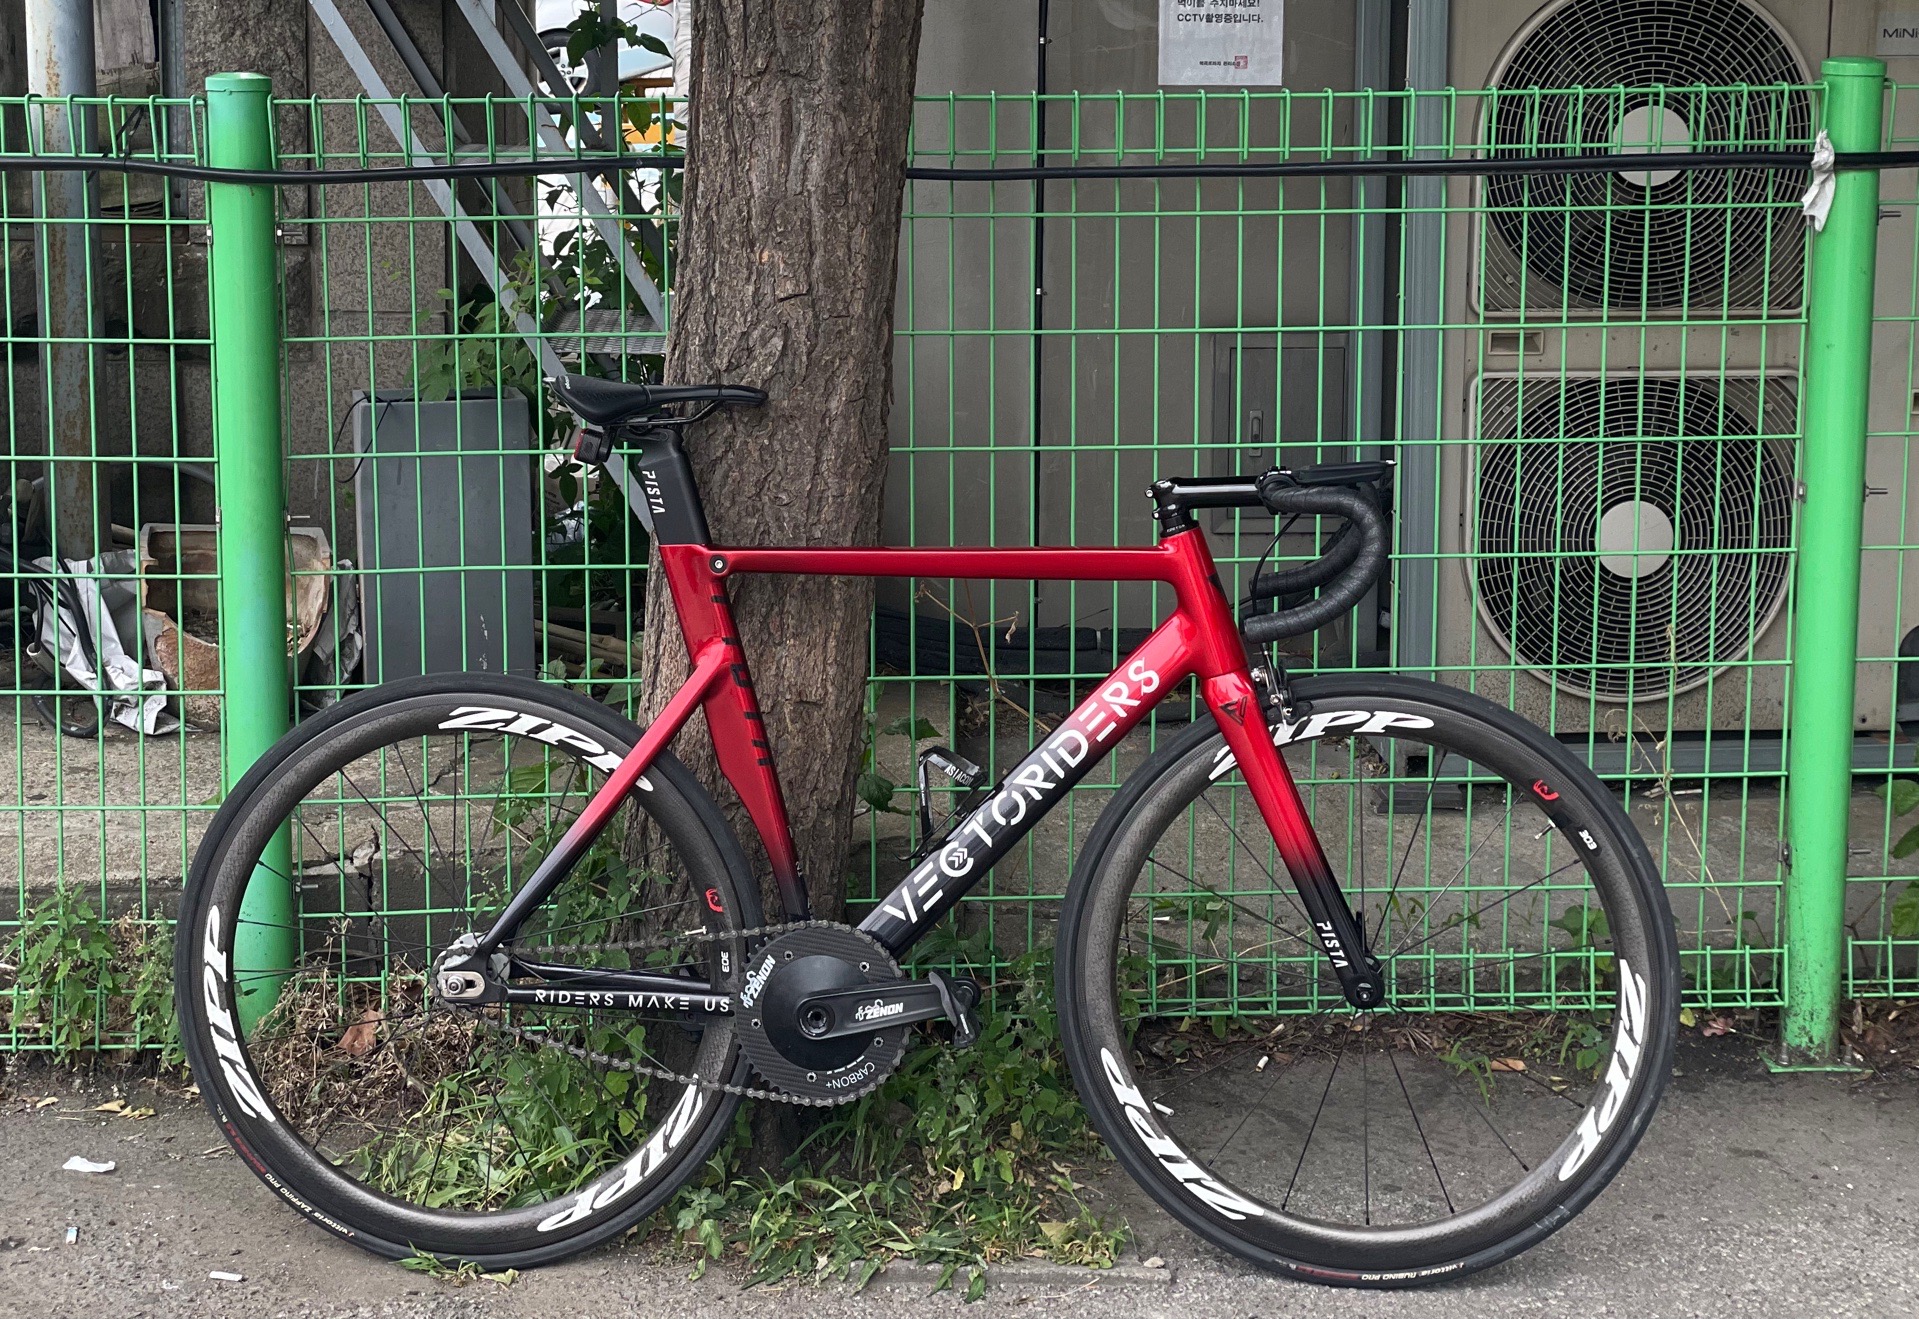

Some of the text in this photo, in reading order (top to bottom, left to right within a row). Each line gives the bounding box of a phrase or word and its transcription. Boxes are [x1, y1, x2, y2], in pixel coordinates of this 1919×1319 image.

[642, 470, 666, 514] PISTA
[1578, 829, 1598, 851] 303
[1316, 920, 1349, 968] PISTA
[720, 951, 730, 973] 303
[748, 954, 777, 999] ZENON
[204, 905, 276, 1123] ZIPP
[535, 989, 730, 1012] RIDERS MAKE US
[865, 1002, 904, 1020] ZENON
[825, 1062, 876, 1089] CARBON+
[1558, 958, 1646, 1182] ZIPP
[1101, 1047, 1265, 1220] ZIPP
[537, 1073, 703, 1232] ZIPP
[264, 1173, 282, 1189] PRO
[1361, 1273, 1381, 1281] PRO
